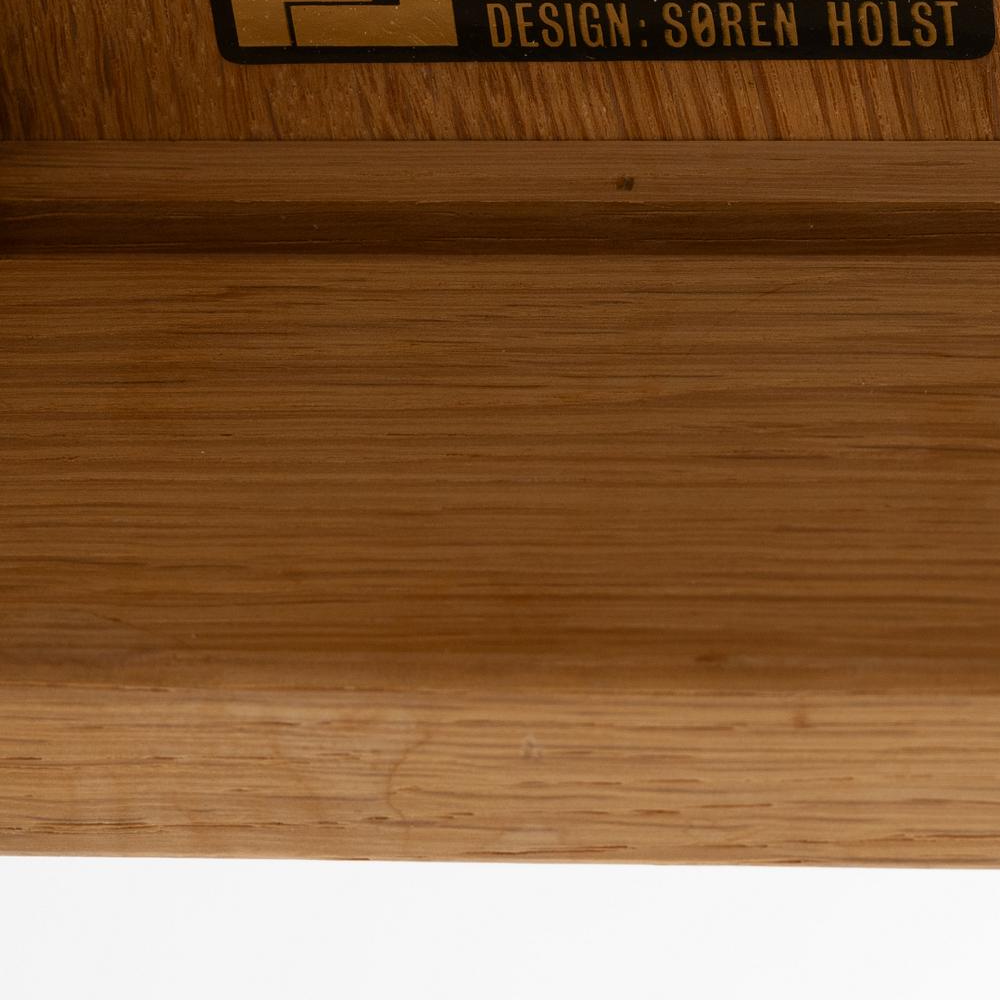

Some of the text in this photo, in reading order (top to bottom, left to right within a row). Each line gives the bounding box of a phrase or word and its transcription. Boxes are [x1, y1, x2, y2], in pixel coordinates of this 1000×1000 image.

[486, 1, 959, 48] DESIGN: SØREN HOLST
